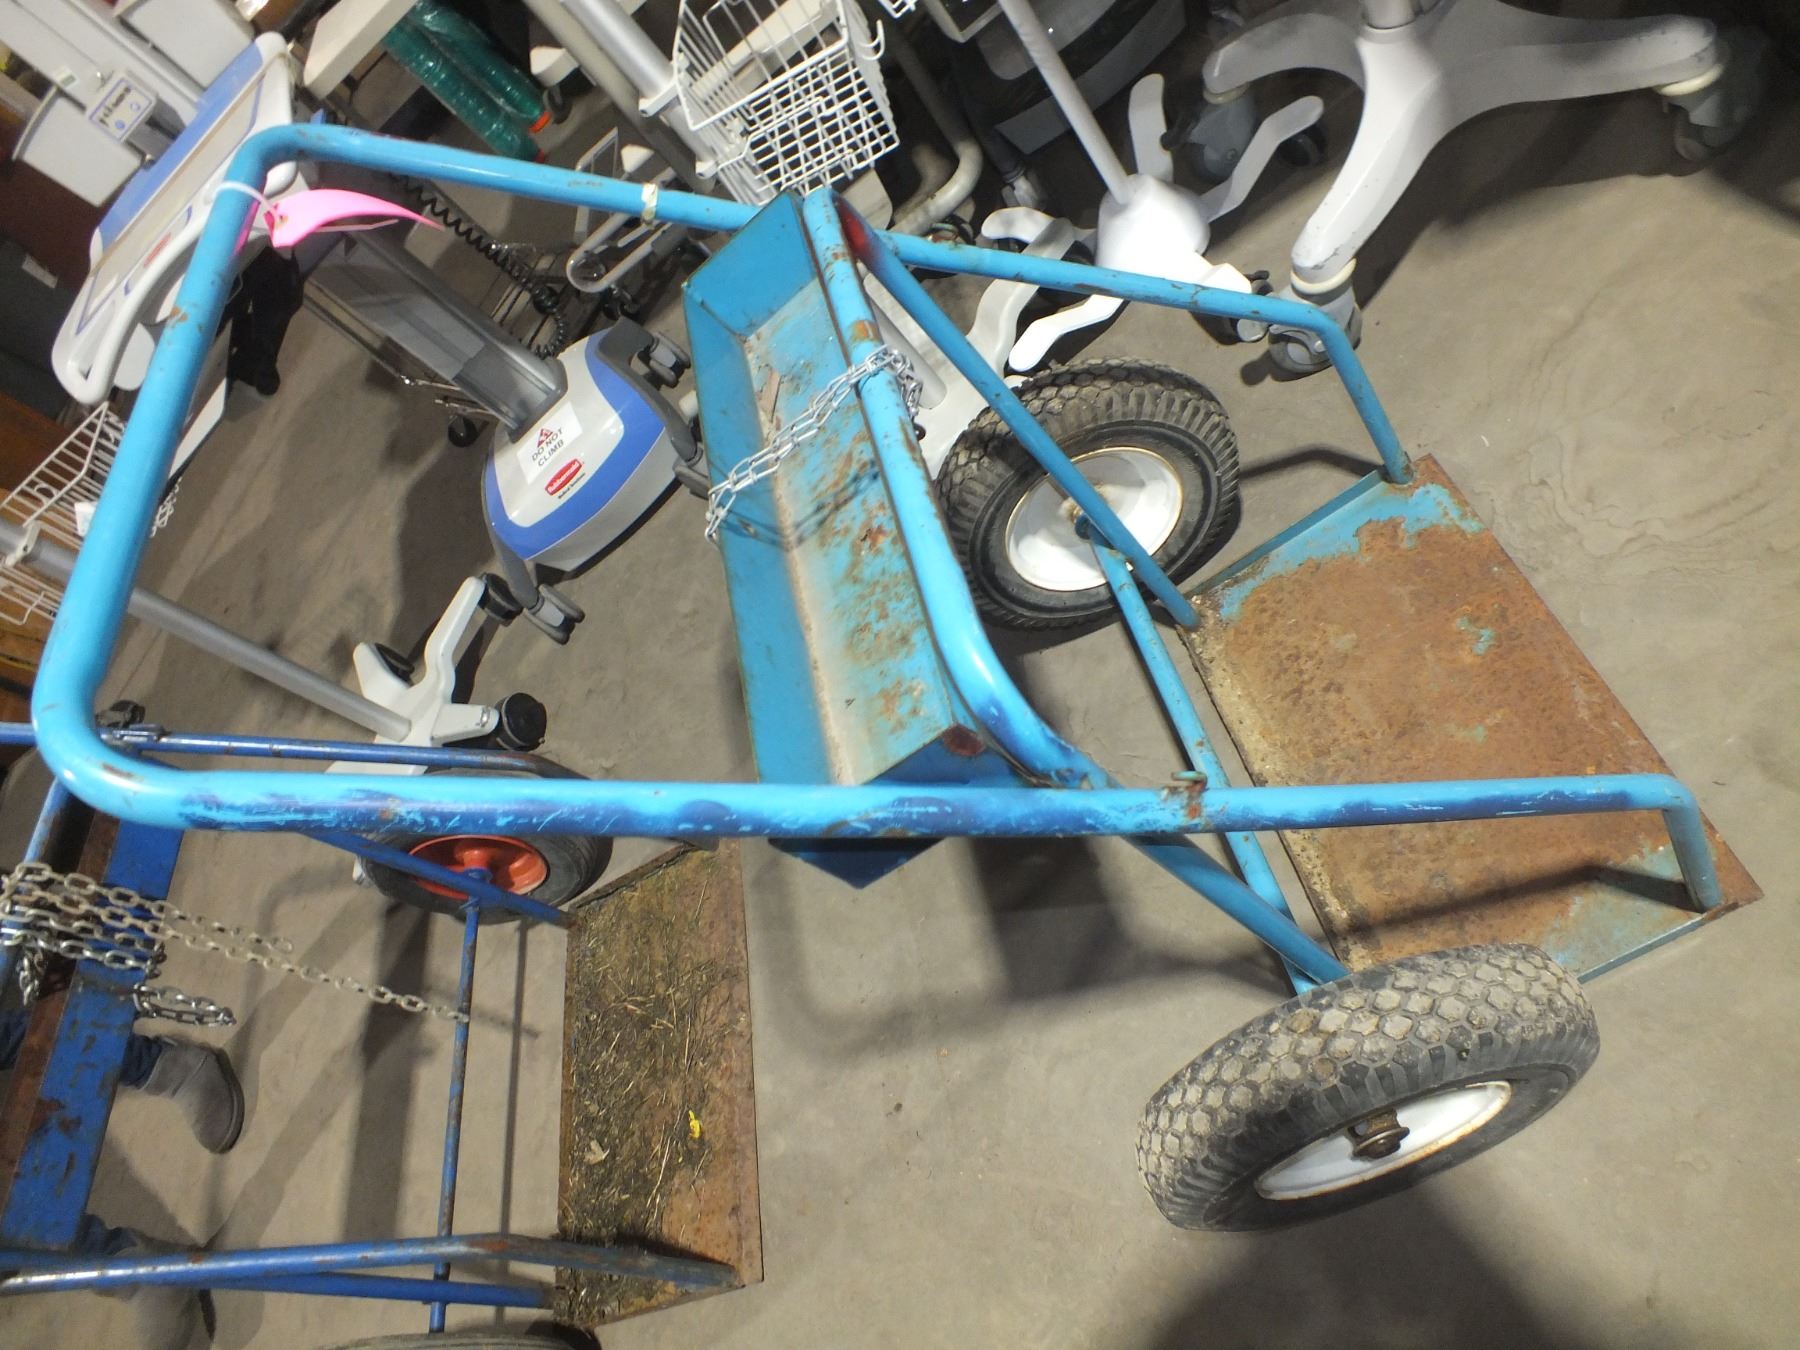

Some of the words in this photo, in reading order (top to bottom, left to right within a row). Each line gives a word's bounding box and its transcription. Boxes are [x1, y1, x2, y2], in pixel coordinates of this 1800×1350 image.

[531, 446, 545, 461] DO
[545, 428, 563, 447] NOT
[538, 439, 564, 466] CLIMB
